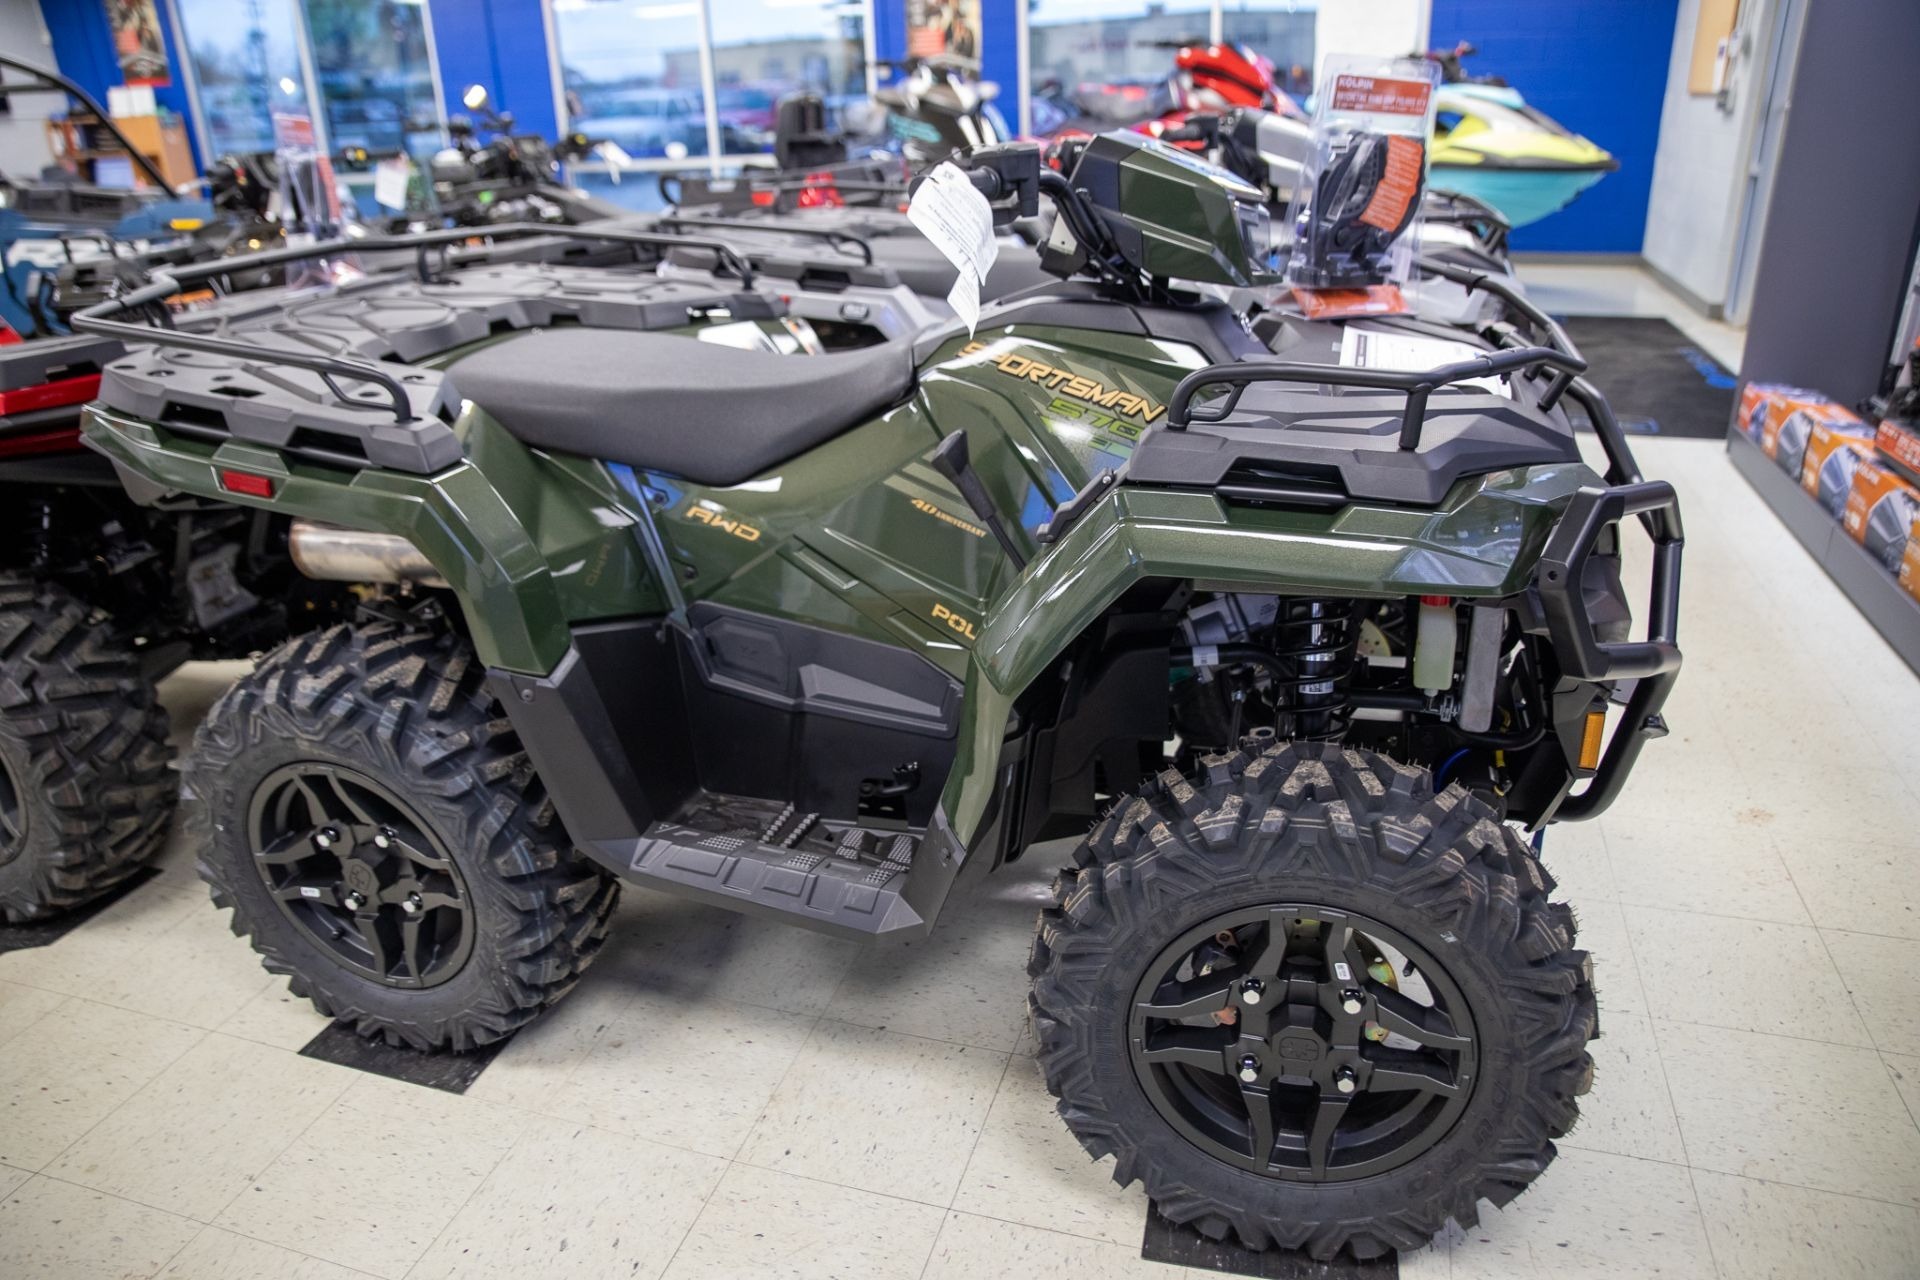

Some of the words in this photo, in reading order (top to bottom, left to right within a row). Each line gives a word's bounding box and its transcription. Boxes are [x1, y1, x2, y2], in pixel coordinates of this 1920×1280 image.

[1338, 77, 1374, 91] KOLPIN
[955, 340, 1167, 422] SORTSMAN
[1047, 397, 1146, 441] 570
[686, 505, 762, 542] AWD
